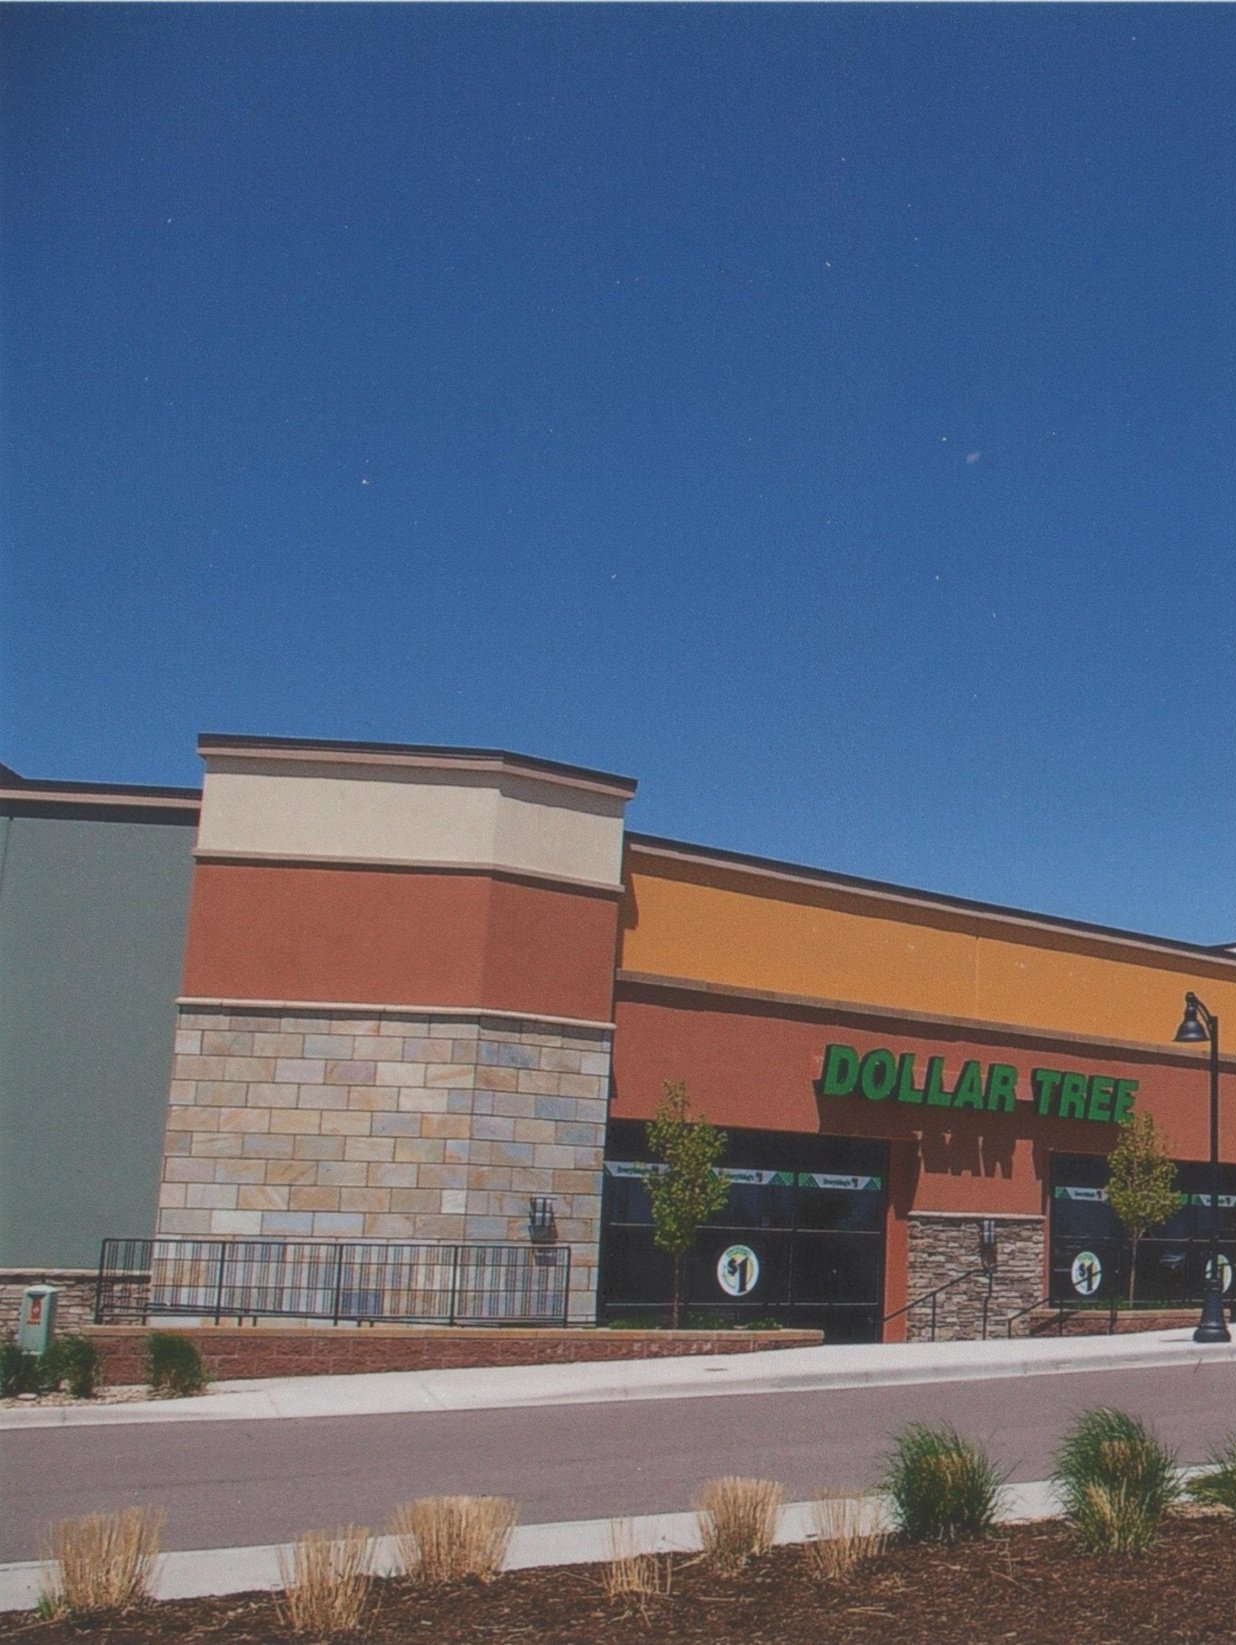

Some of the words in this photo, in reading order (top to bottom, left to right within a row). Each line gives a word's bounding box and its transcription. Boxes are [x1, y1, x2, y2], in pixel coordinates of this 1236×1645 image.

[823, 1044, 1018, 1112] DOLLAR
[1031, 1068, 1139, 1123] TREE
[727, 1256, 749, 1293] $1
